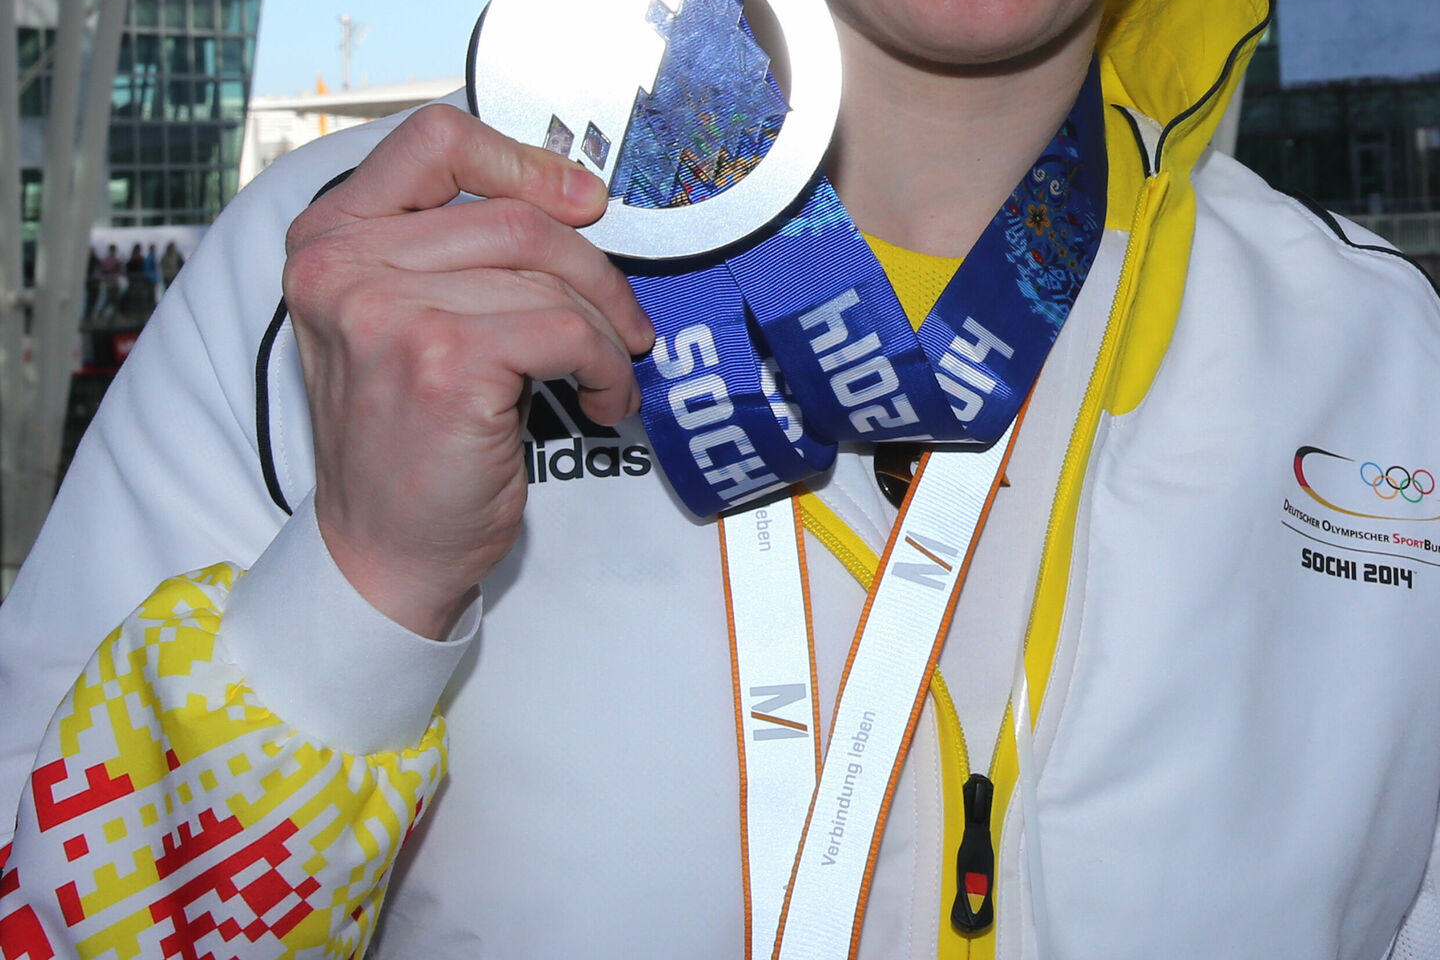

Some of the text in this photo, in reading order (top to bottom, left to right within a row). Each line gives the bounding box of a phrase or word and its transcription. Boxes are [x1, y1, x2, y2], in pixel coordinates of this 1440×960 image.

[798, 287, 920, 433] 2014
[935, 315, 1015, 428] 014
[524, 437, 652, 484] idas
[755, 509, 772, 552] eben
[1301, 547, 1413, 589] SOCHI 2014
[821, 710, 876, 867] Verbindung leben
